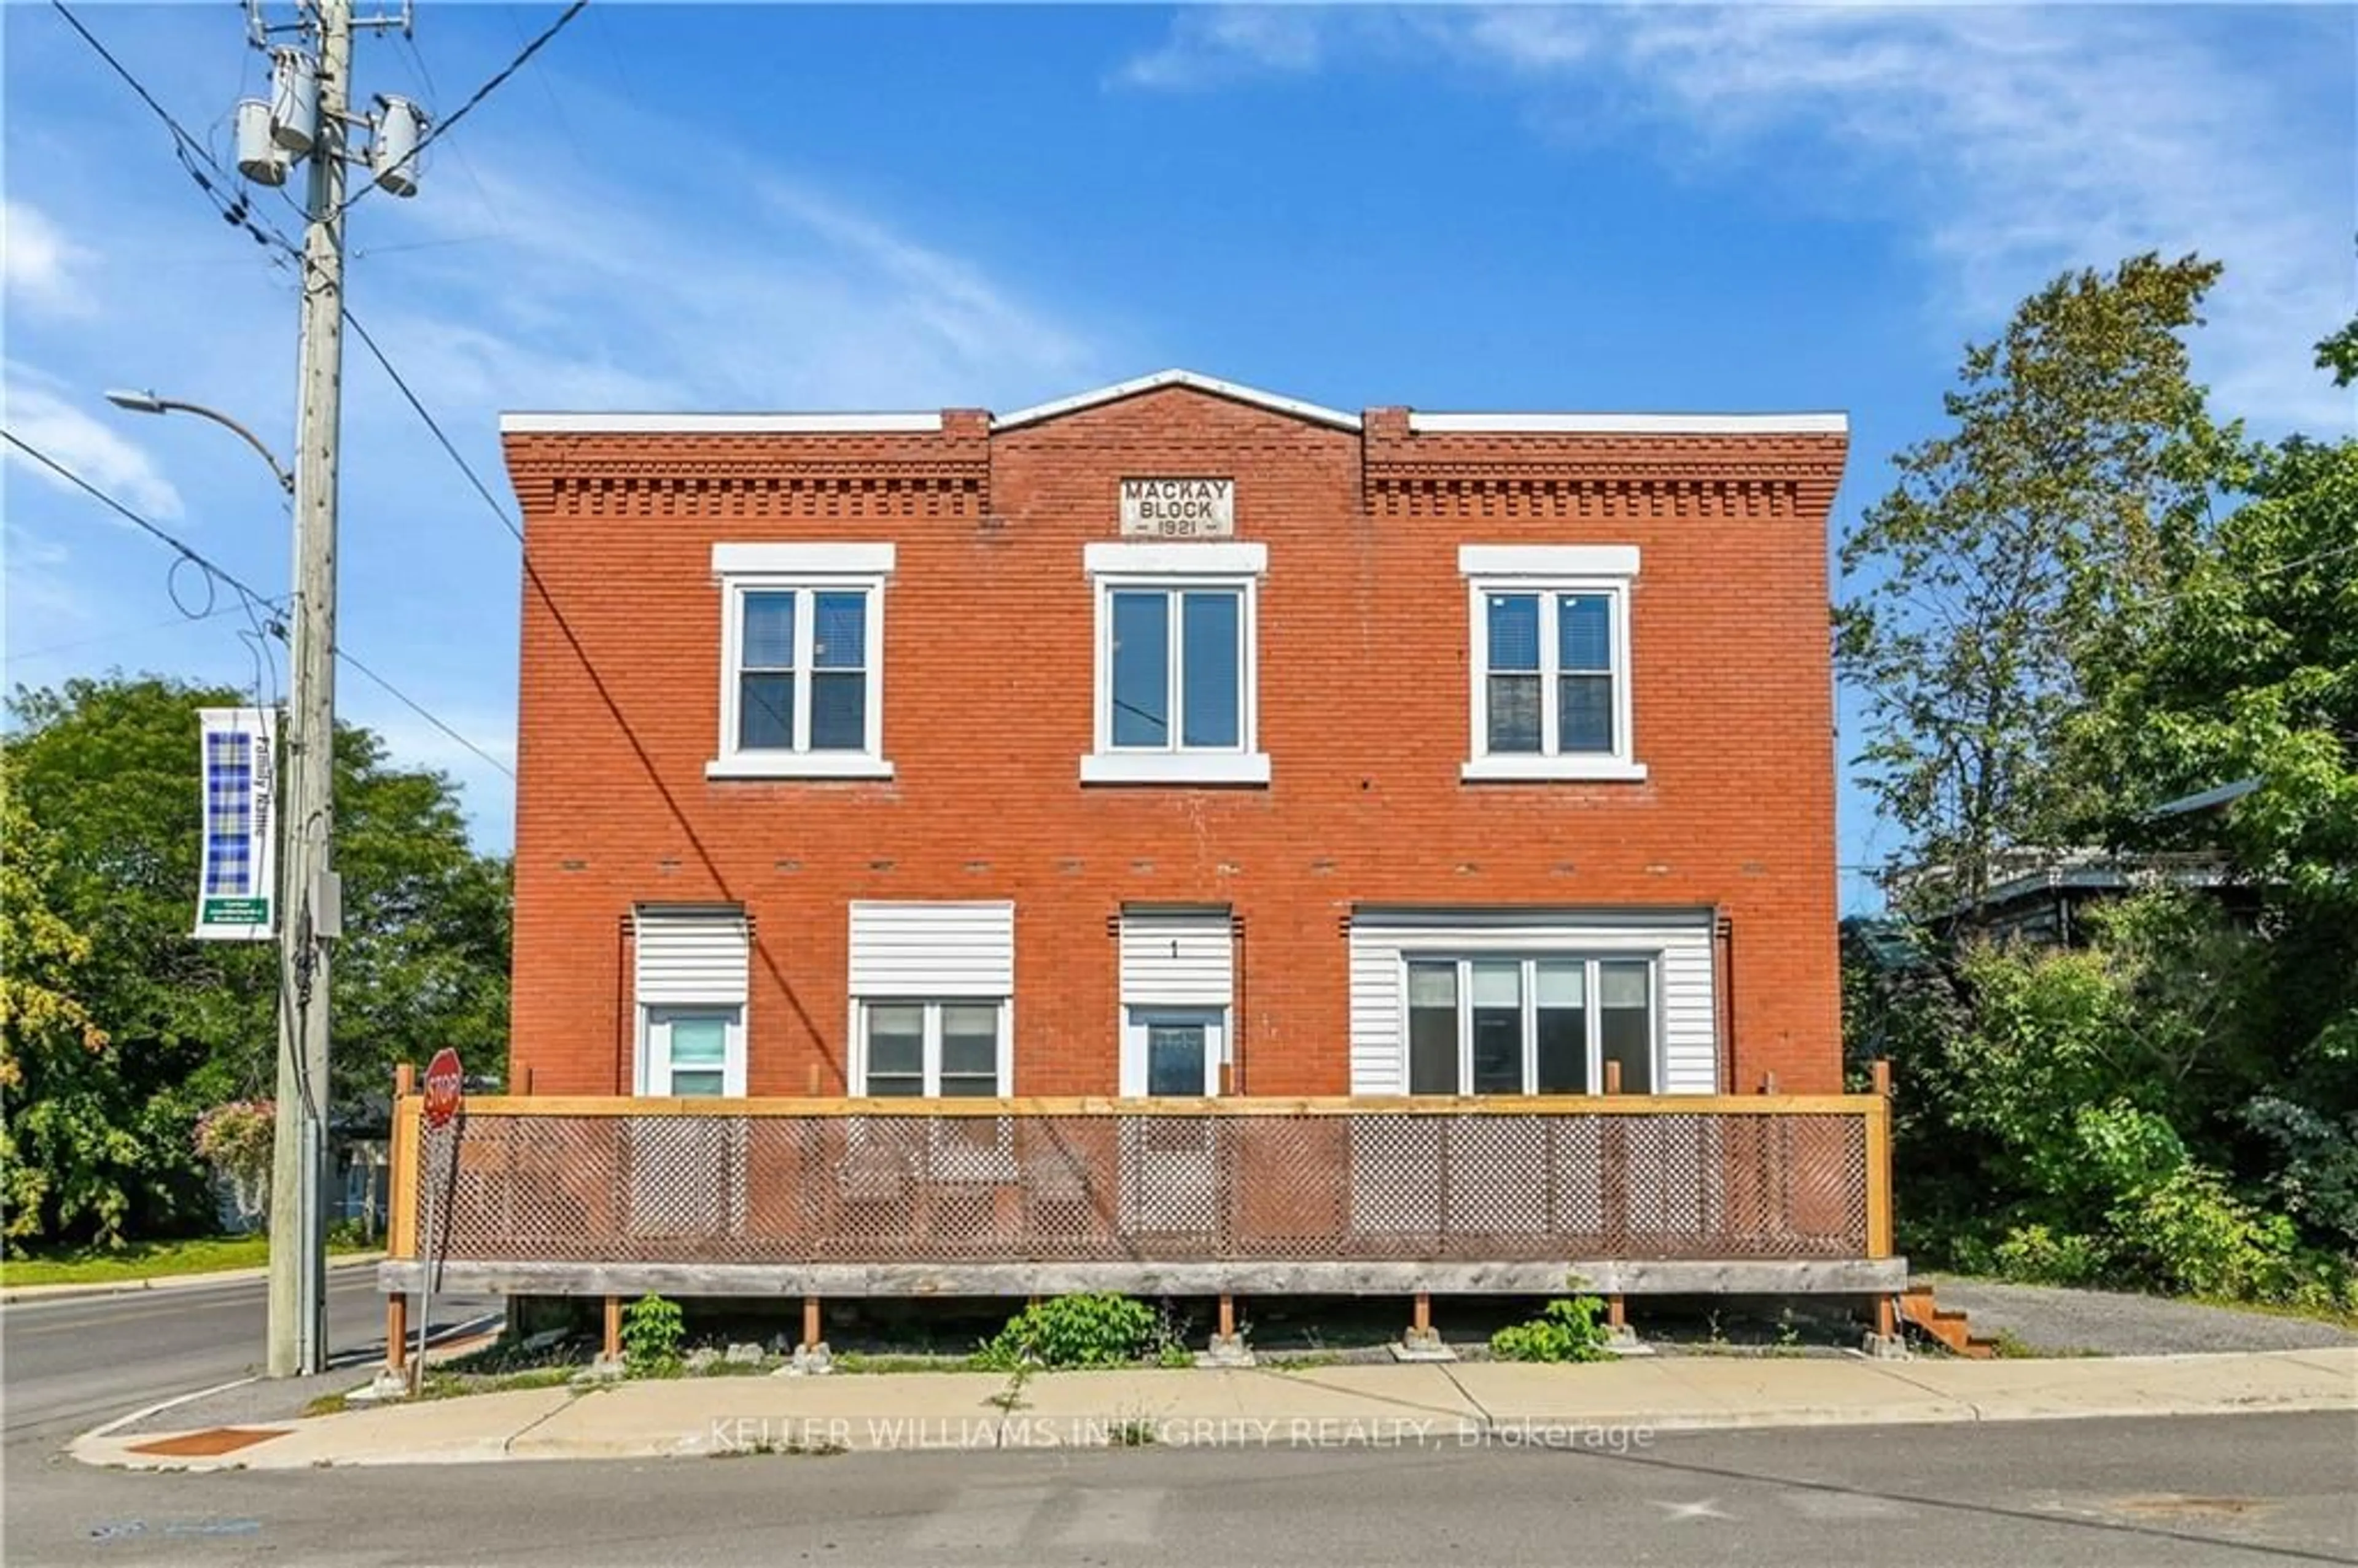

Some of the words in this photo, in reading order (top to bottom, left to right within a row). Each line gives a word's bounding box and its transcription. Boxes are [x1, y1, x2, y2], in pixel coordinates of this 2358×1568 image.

[1125, 481, 1228, 499] MACKAY
[1140, 501, 1212, 519] BLOCK
[1170, 939, 1178, 958] 1
[428, 1073, 460, 1106] STOP
